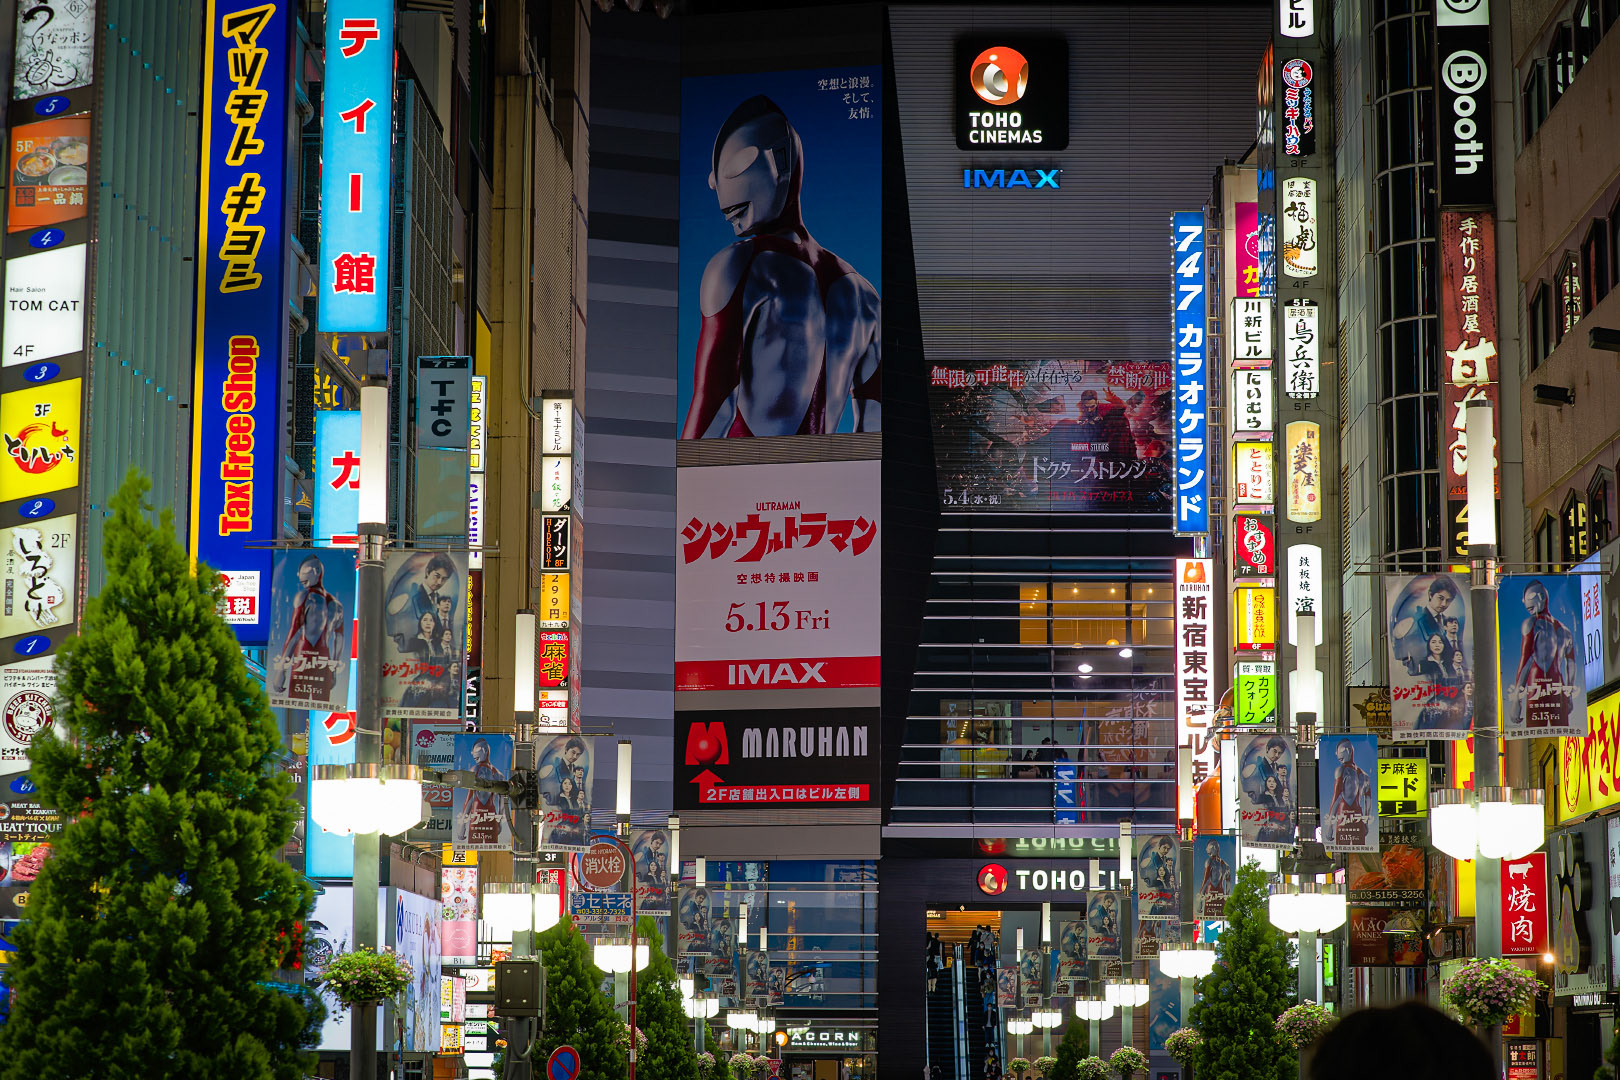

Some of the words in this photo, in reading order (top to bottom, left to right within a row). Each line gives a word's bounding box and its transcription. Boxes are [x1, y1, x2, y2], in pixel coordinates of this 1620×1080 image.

[69, 0, 84, 13] 6F
[37, 32, 91, 45] うなッポン
[817, 76, 875, 92] 空想と浪漫。
[45, 99, 58, 113] 5
[842, 93, 875, 105] そして、
[848, 107, 875, 121] 友情。
[1303, 87, 1313, 134] うたえるパブ
[1441, 50, 1487, 175] Booth
[968, 112, 1022, 128] TOHO
[1285, 88, 1300, 154] ミッキーハウス
[968, 130, 1043, 144] CINEMAS
[16, 140, 33, 152] 5F
[219, 3, 276, 294] マツモトキヨシ
[1290, 159, 1307, 168] 3F
[963, 169, 1060, 189] IMAX
[37, 192, 84, 205] 一品鍋
[1284, 201, 1316, 251] 福虎
[41, 233, 52, 245] 4
[1458, 216, 1481, 333] 手作り居酒屋
[1292, 280, 1310, 289] 4F
[10, 301, 43, 311] TOM
[48, 300, 80, 311] CAT
[1293, 298, 1310, 306] 5F
[1290, 308, 1313, 317] 居酒屋
[1244, 301, 1262, 357] 川新ビル
[13, 345, 35, 357] 4F
[35, 366, 48, 379] 3
[222, 334, 259, 412] Shop
[931, 365, 1083, 388] 無限の可能性が存在する
[1108, 365, 1172, 390] 禁断の世
[34, 404, 51, 417] 3F
[430, 379, 456, 437] TFC
[1293, 403, 1311, 411] 5F
[1178, 323, 1206, 521] カラオケランド
[4, 433, 76, 470] とりいち
[221, 413, 256, 481] Free
[1032, 456, 1148, 484] ドクター・ストレンジ
[29, 501, 43, 515] 2
[219, 480, 253, 536] Tax
[755, 500, 801, 512] ULTRAMAN
[1295, 526, 1313, 534] 6F
[51, 533, 71, 548] 2F
[553, 518, 567, 558] ダーツ
[680, 512, 878, 565] シン・ウルトラマン
[6, 549, 15, 575] 居酒屋
[554, 559, 564, 568] 8F
[1241, 566, 1251, 574] 7F
[1298, 556, 1310, 592] 鉄板焼
[19, 537, 51, 621] いろどり
[736, 571, 819, 585] 空想特撮映画
[1179, 584, 1210, 592] MARUHAN
[725, 600, 790, 633] 5.13
[794, 609, 831, 631] Fri
[26, 639, 38, 653] 1
[542, 642, 566, 681] 麻雀
[728, 662, 828, 685] IMAX
[1242, 665, 1271, 674] 質・買取
[294, 684, 312, 694] 5.13
[312, 686, 323, 694] Fri
[7, 696, 23, 715] BEEF
[25, 694, 52, 716] KITCHEN
[1244, 681, 1255, 721] クォーク
[1531, 711, 1550, 721] 5.13
[1550, 713, 1561, 721] Fri
[742, 725, 868, 759] MARUHAN
[706, 785, 860, 802] 2F店舗出入口はビル左側
[545, 853, 557, 861] 3F
[585, 856, 621, 874] 消火栓
[1015, 869, 1086, 891] TOHO
[587, 893, 631, 908] セキネ
[1508, 883, 1536, 944] 焼肉
[791, 1032, 859, 1041] ACORN
[1510, 1050, 1536, 1061] 甘太郎
